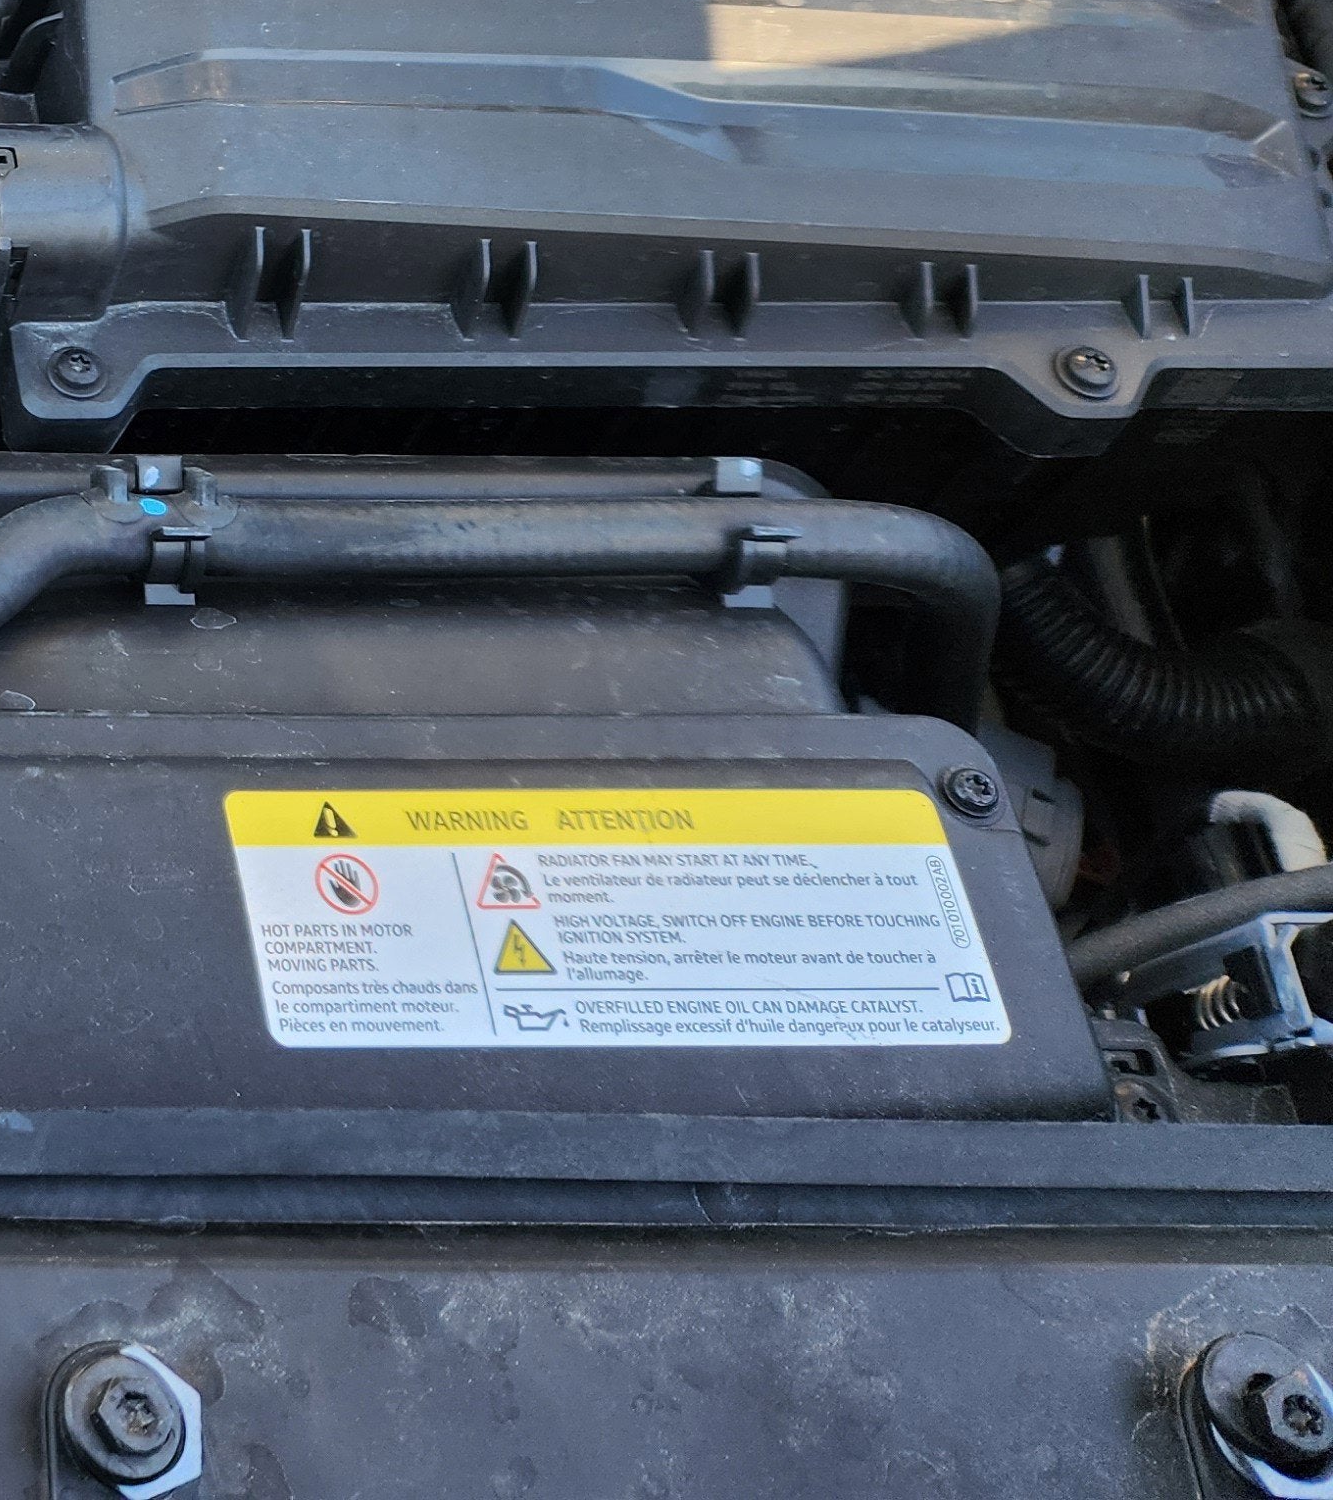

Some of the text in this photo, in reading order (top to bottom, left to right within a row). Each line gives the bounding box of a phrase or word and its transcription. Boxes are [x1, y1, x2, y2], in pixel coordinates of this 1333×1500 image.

[405, 809, 695, 831] WARNING ATTENTION
[537, 854, 811, 867] RADIATOR FAN MAY START AT ANY TIME.
[543, 873, 918, 888] Le ventilateur de radiateur peut se déclencher à tout
[548, 891, 614, 903] moment.
[554, 915, 940, 928] HIGH VOLTAGE, SWITCH OFF ENGINE BEFORE TOUCHING
[260, 924, 413, 937] HOT PARTS IN MOTOR
[558, 931, 686, 944] IGNITION SYSTEM.
[265, 941, 378, 954] COMPARTMENT.
[563, 949, 937, 966] Haute tension, arrêter le moteur avant de toucher à
[267, 958, 379, 972] MOVING PARTS.
[567, 967, 649, 983] l'allumage.
[272, 980, 478, 997] Composants très chauds dans
[276, 1000, 459, 1017] le compartiment moteur.
[576, 1000, 923, 1014] OVERFILLED ENGINE OIL CAN DAMAGE CATALYST.
[279, 1018, 445, 1032] Pièces en mouvement.
[580, 1018, 1000, 1036] Remplissage excessif d'huile dangereux pour le catalyseur.
